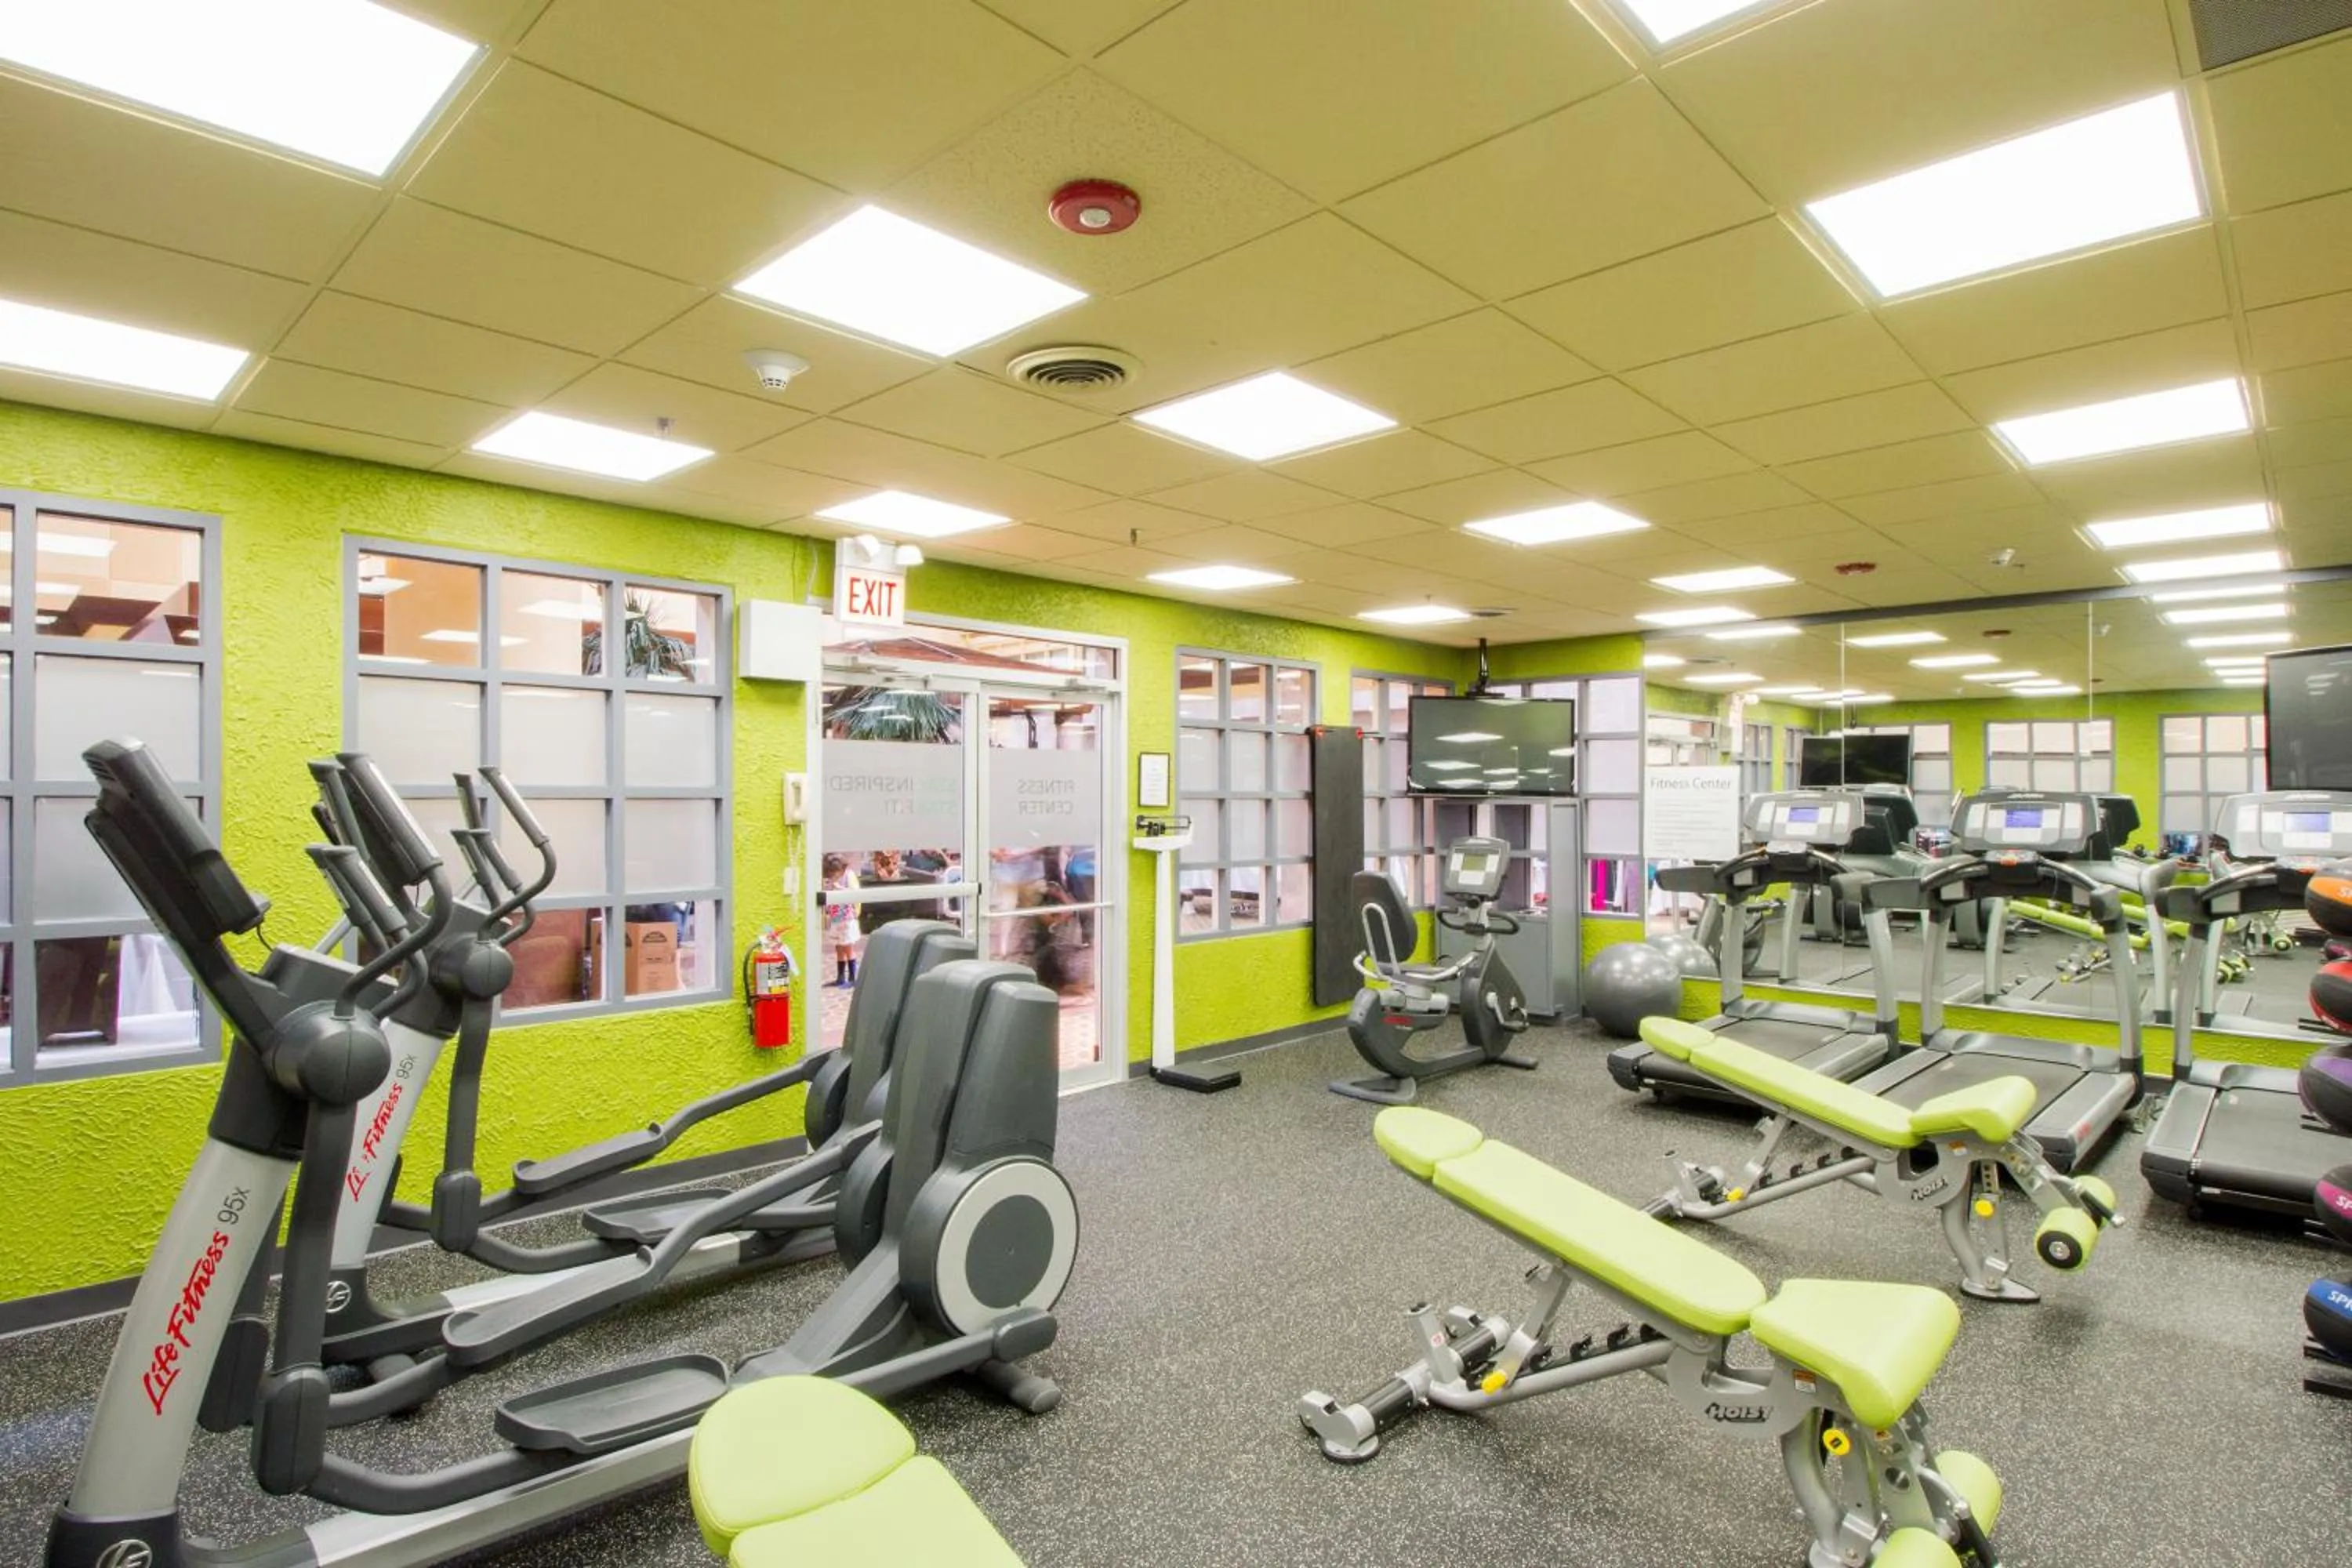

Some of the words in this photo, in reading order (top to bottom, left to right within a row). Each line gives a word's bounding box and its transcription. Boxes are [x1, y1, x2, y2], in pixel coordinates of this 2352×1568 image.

[849, 576, 897, 617] EXIT
[1650, 777, 1690, 789] Fitness
[1692, 777, 1731, 789] Center
[362, 1080, 404, 1159] Fitness
[143, 1342, 181, 1416] Life
[165, 1230, 229, 1348] Fitness
[1705, 1403, 1773, 1423] HOIST
